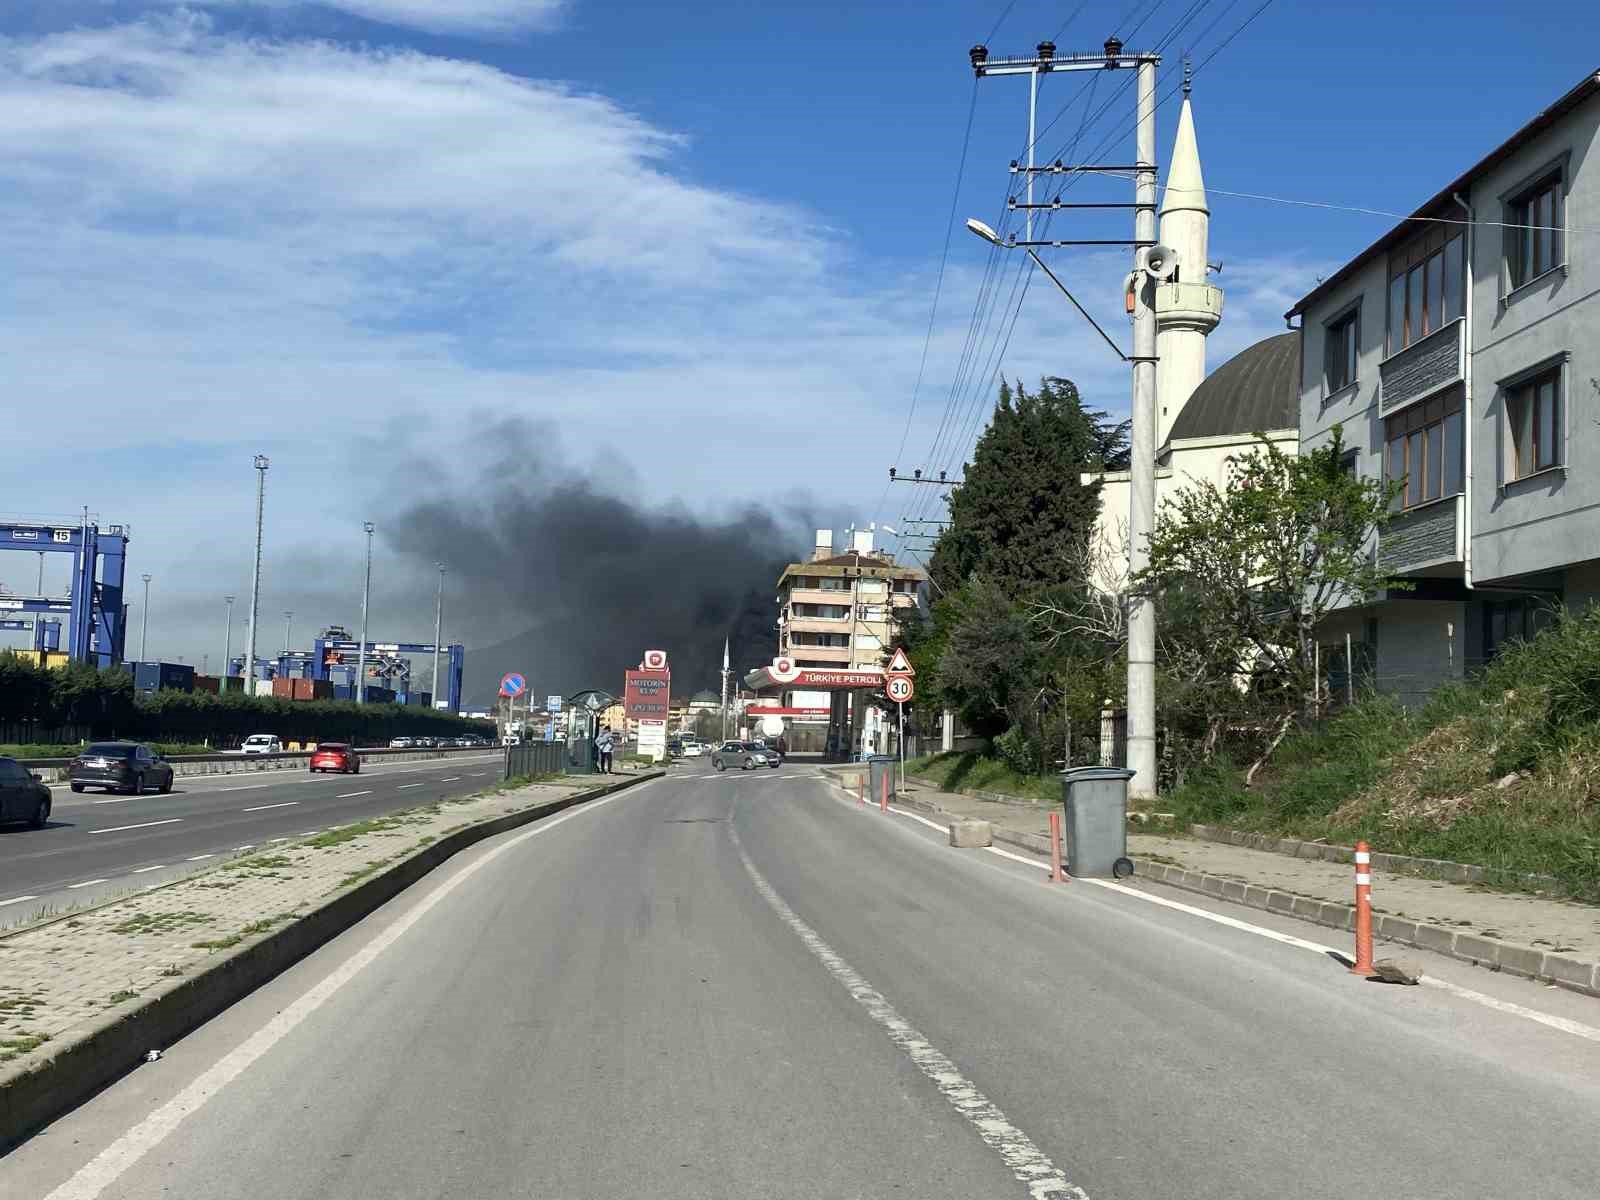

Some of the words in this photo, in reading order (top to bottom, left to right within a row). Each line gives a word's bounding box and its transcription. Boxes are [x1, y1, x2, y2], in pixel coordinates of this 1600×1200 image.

[55, 531, 68, 541] 15
[805, 672, 841, 682] TÜRKİYE
[892, 682, 909, 694] 30
